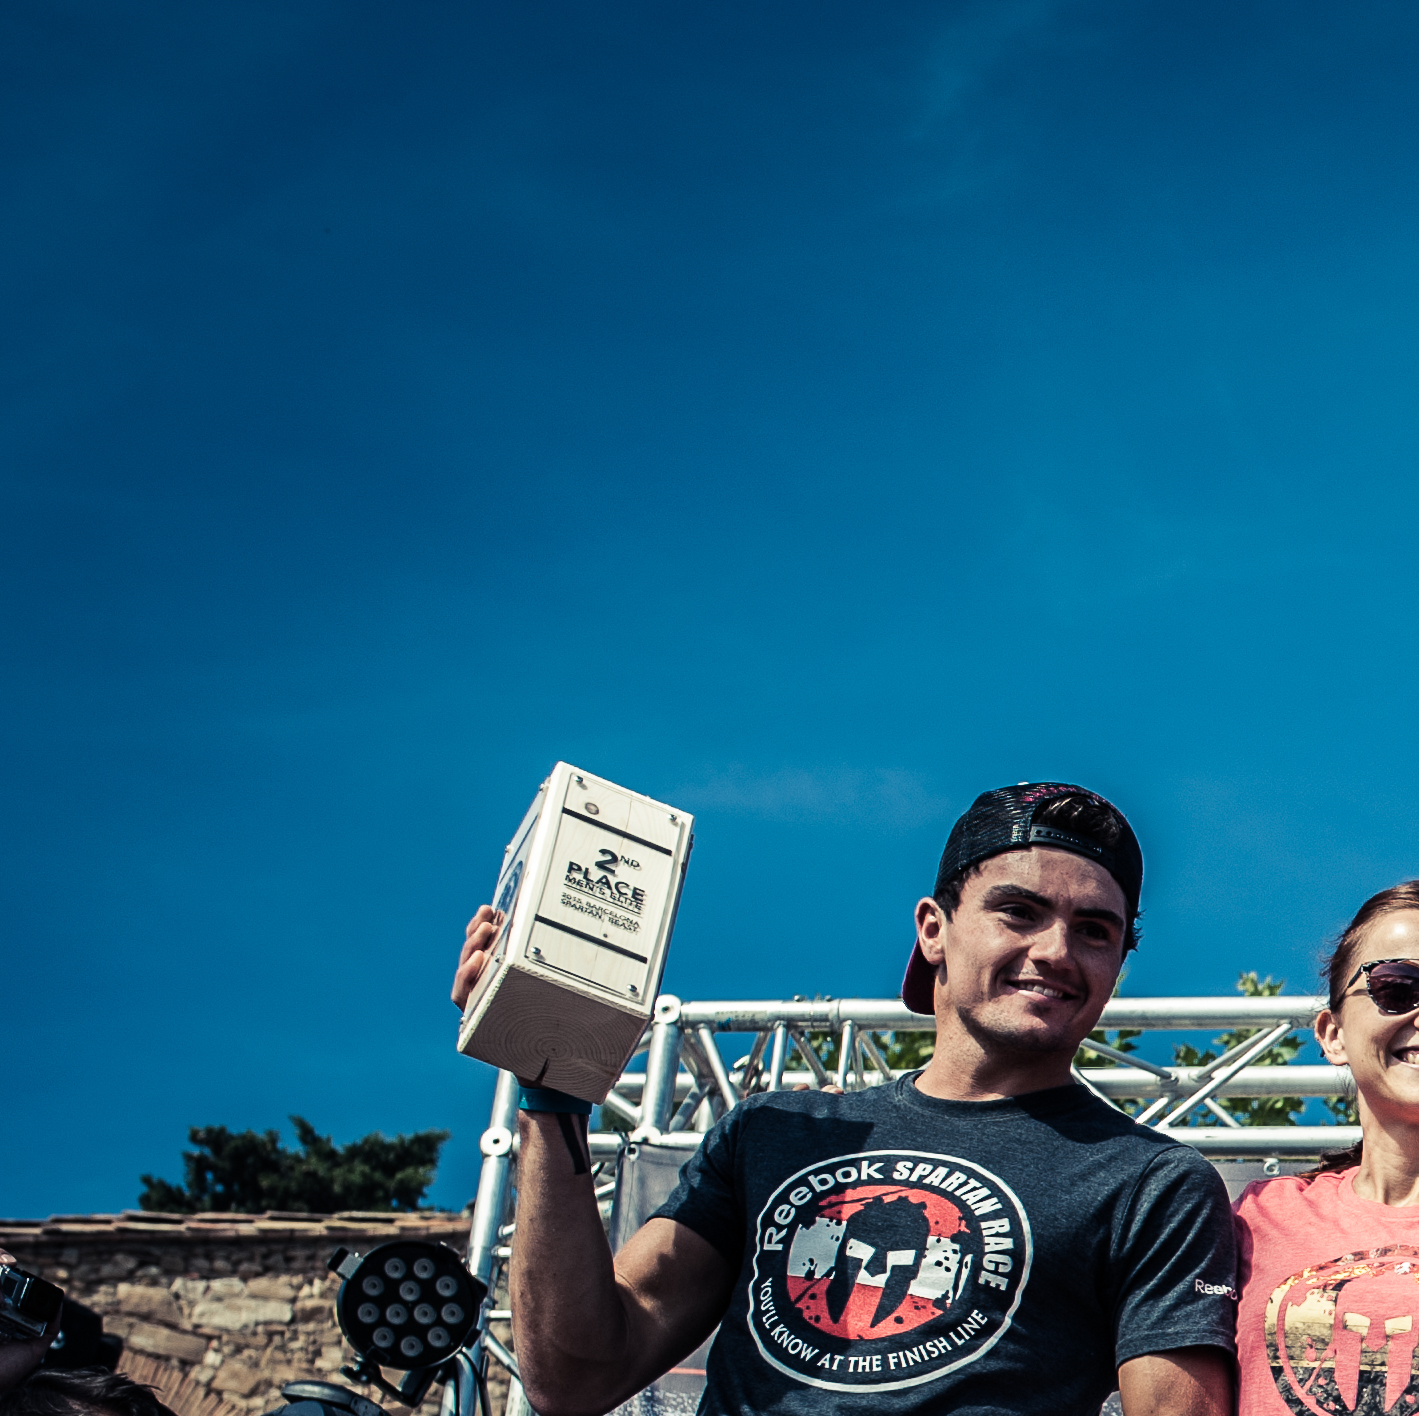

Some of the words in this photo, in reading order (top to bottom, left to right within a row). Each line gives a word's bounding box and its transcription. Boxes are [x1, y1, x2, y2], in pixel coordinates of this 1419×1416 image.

[566, 861, 646, 902] PLACE
[763, 1160, 884, 1250] Reebok
[892, 1161, 1002, 1216] SPARTAN
[978, 1217, 1014, 1291] RACE
[760, 1277, 773, 1329] YOU'LL
[770, 1323, 819, 1362] KNOW
[817, 1354, 844, 1371] AT
[848, 1355, 882, 1372] THE
[889, 1336, 952, 1371] FINISH
[948, 1309, 988, 1346] LINE
